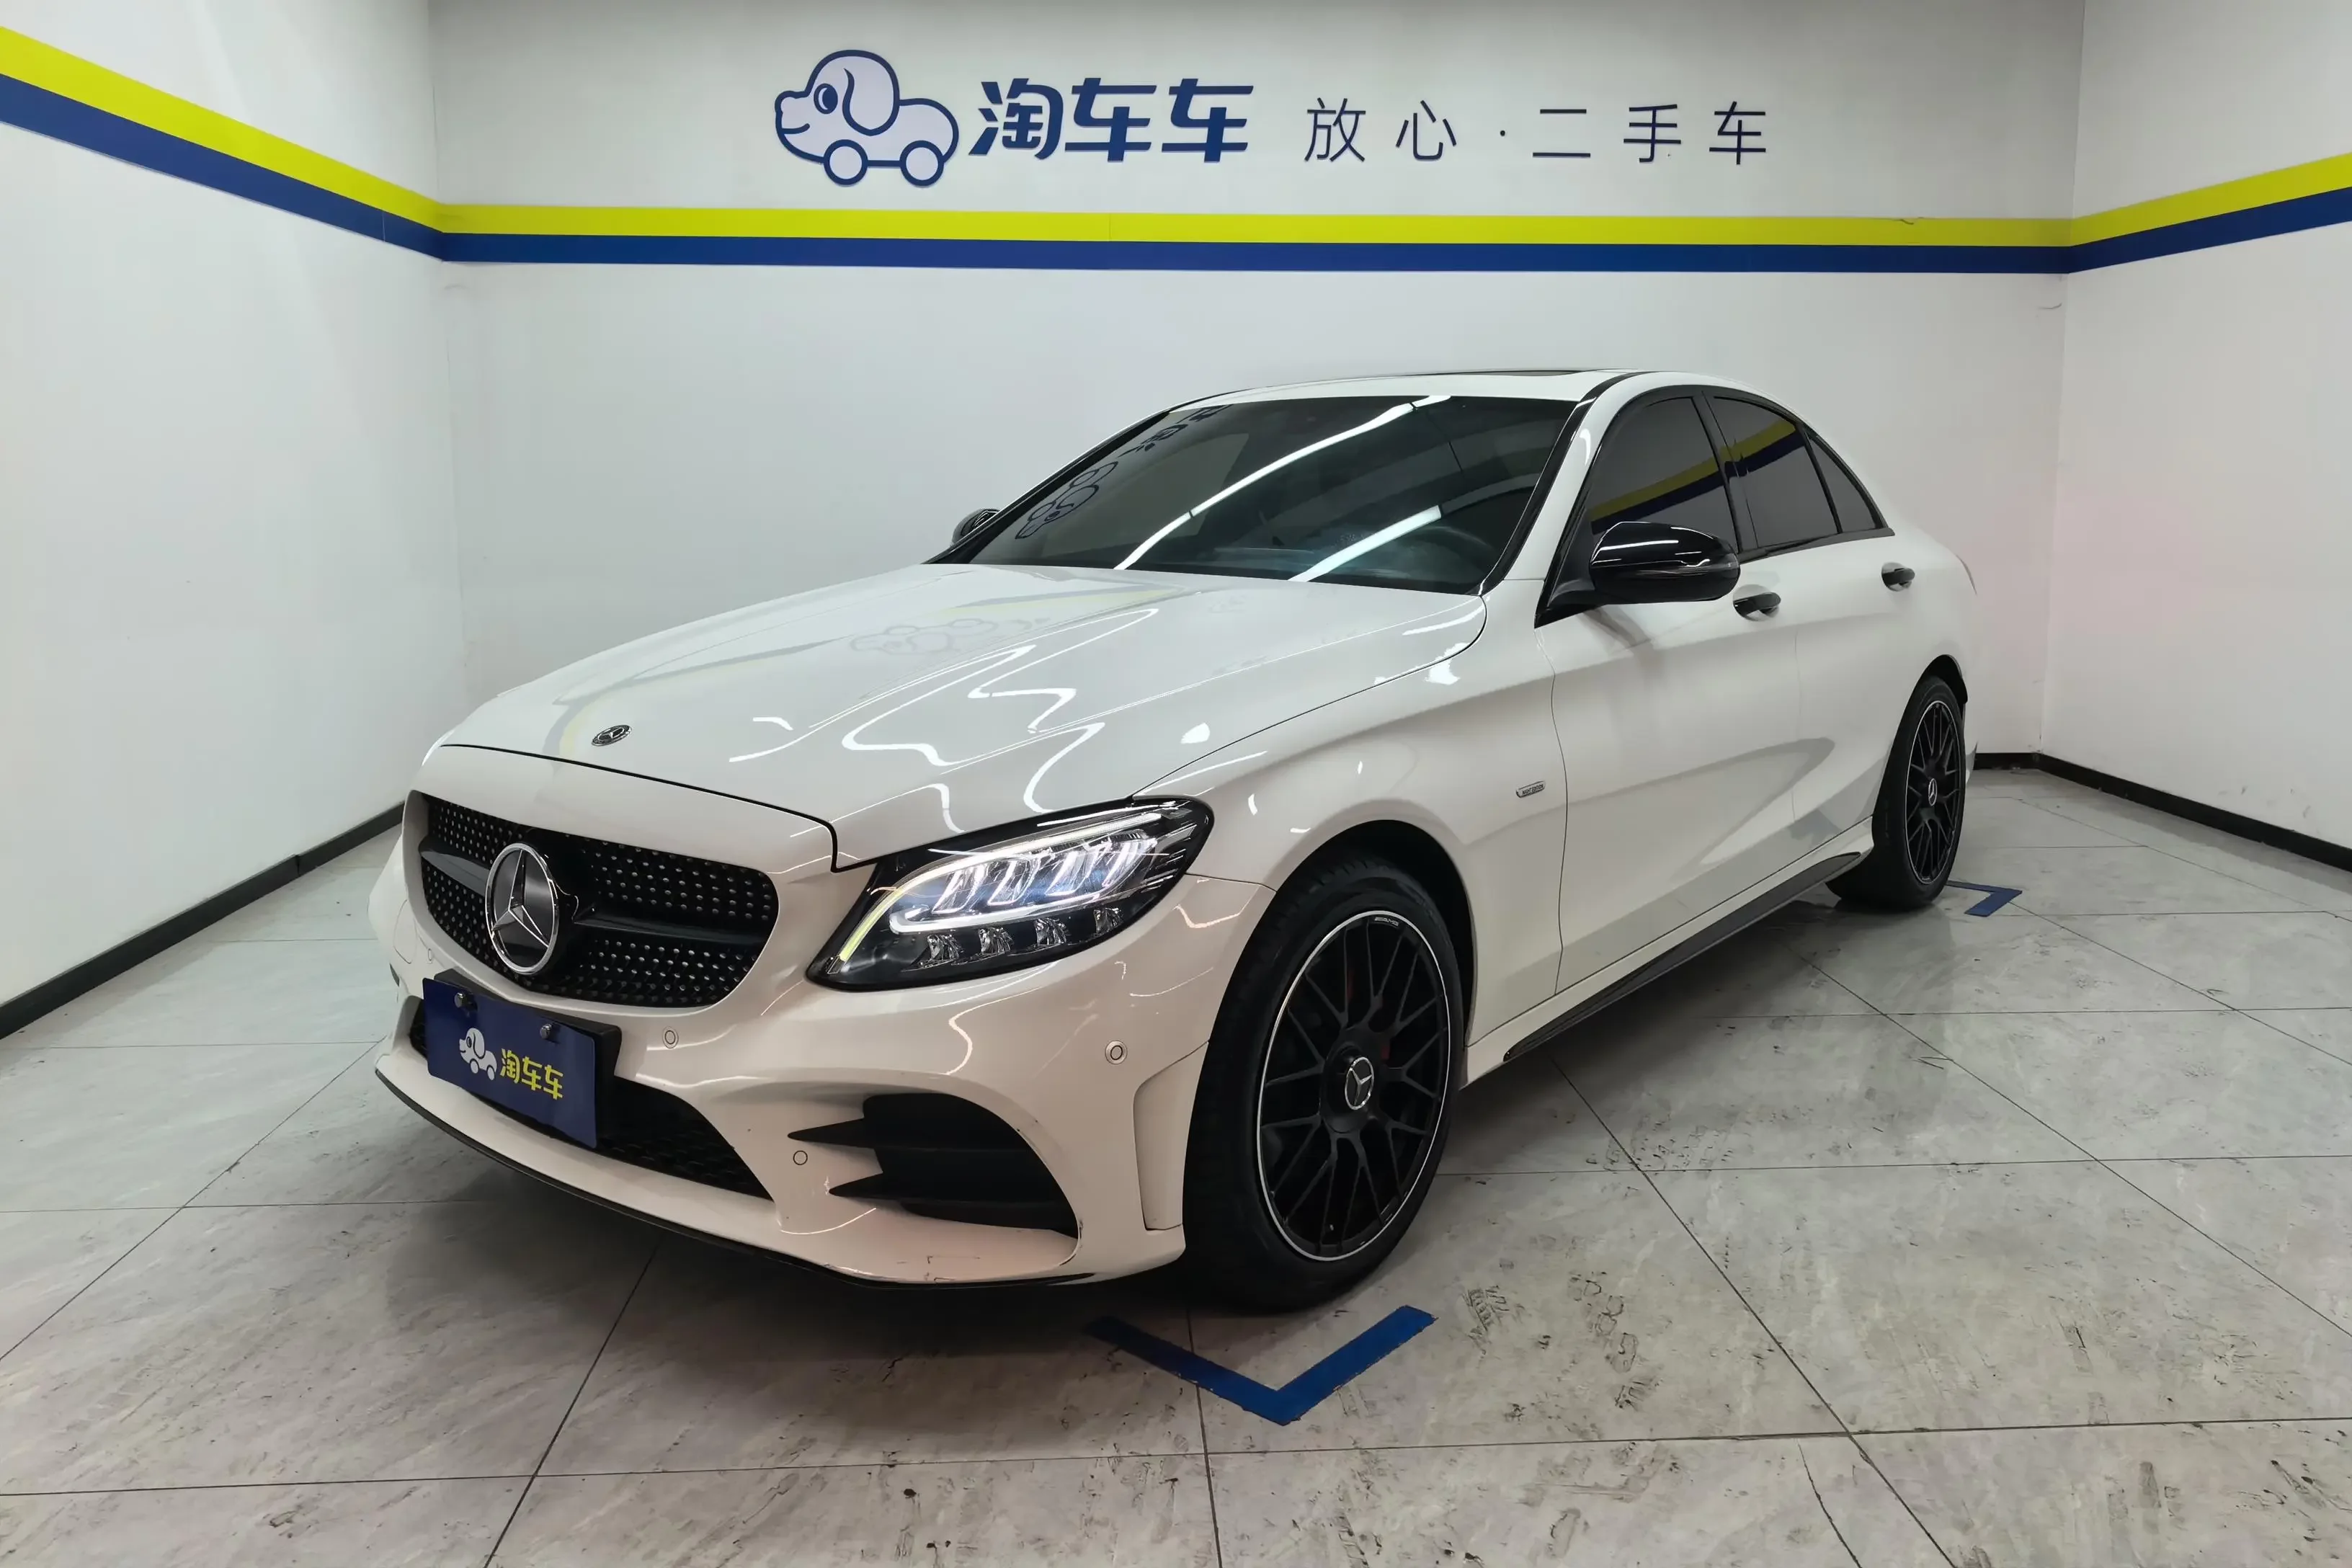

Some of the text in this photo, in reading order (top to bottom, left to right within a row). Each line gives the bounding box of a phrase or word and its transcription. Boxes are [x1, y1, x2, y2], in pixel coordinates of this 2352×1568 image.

[968, 78, 1253, 162] 淘车车
[500, 1048, 564, 1100] 淘车车
